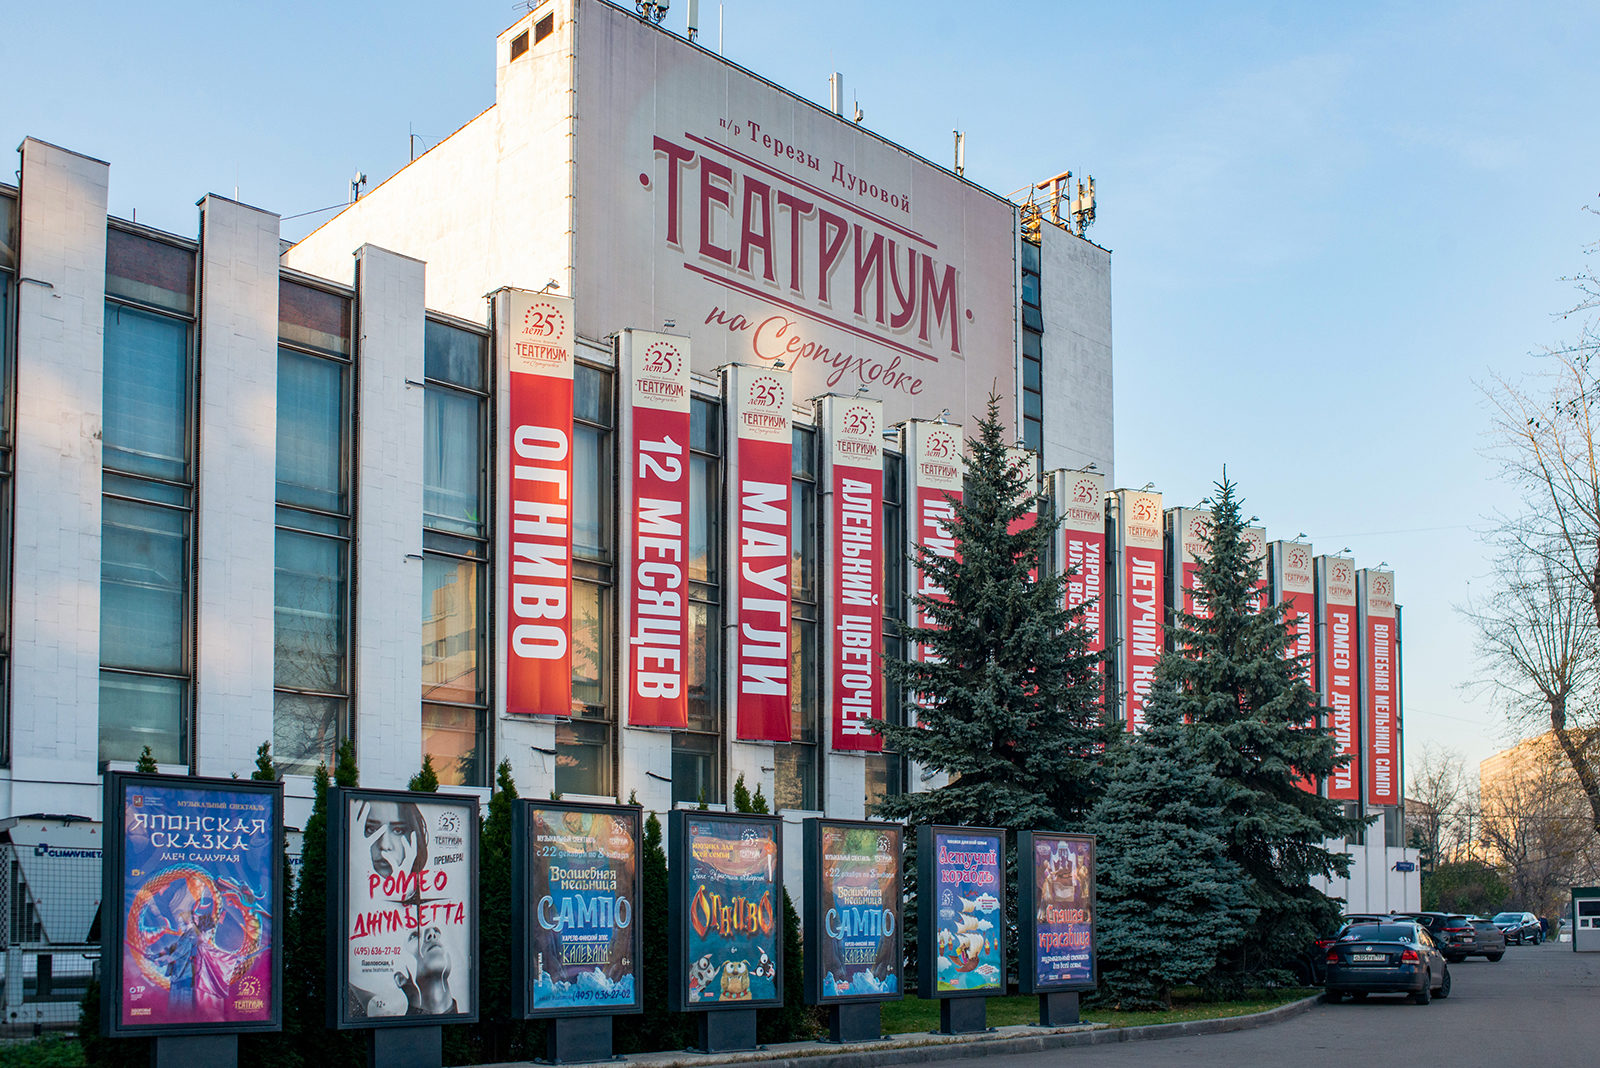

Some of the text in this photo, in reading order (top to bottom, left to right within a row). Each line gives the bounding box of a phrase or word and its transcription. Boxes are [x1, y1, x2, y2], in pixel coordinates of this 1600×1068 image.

[719, 117, 911, 214] п/р Терезы Дуровой
[653, 135, 961, 354] ТЕАТРИУМ
[522, 326, 544, 337] лет
[532, 312, 556, 337] 25
[516, 342, 567, 362] ТЕАТРИУМ
[704, 305, 924, 396] на Серпуховке
[643, 363, 663, 373] лет
[652, 350, 674, 374] 25
[637, 379, 684, 397] ТЕАТРИУМ
[756, 384, 777, 406] 25
[747, 397, 767, 406] лет
[742, 412, 786, 429] ТЕАТРИУМ
[850, 413, 868, 435] 25
[841, 426, 859, 434] лет
[837, 440, 877, 456] ТЕАТРИУМ
[932, 438, 949, 458] 25
[639, 435, 683, 483] 12
[920, 463, 958, 478] ТЕАТРИУМ
[1078, 485, 1093, 503] 25
[1069, 508, 1100, 521] ТЕАТРИУМ
[1137, 504, 1152, 521] 25
[1128, 526, 1159, 537] ТЕАТРИУМ
[512, 424, 568, 660] ОГНИВО
[842, 478, 878, 607] АЛЕНЬКИЙ
[1292, 554, 1303, 568] 25
[1335, 568, 1346, 582] 25
[742, 479, 787, 697] МАУГЛИ
[1376, 581, 1387, 595] 25
[630, 497, 682, 700] МЕСЯЦЕВ
[1132, 557, 1162, 657] ЛЕТУЧИЙ
[1333, 612, 1349, 670] РОМЕО
[837, 614, 872, 736] ЦВЕТОЧЕК
[1333, 675, 1350, 687] И
[1373, 624, 1390, 797] ВОЛШЕБНАЯ МЕЛЬНИЦА САМПО
[177, 800, 265, 811] МУЗЫКАЛЬНЫЙ СПЕКТАКЛЬ
[129, 813, 265, 836] ЯПОНСКАЯ
[443, 817, 456, 831] 25
[151, 832, 249, 850] СКАЗКА
[160, 852, 240, 863] МЕЧ САМУРАЯ
[542, 846, 557, 857] 22
[939, 845, 997, 869] Летучий
[550, 866, 617, 881] Волшебная
[829, 868, 840, 877] 22
[941, 864, 994, 887] корабль
[368, 870, 448, 899] РОМЕО
[561, 880, 617, 892] мельница
[837, 886, 882, 898] Волшебная
[349, 902, 466, 941] ДЖУЛЬЕТТА
[537, 894, 632, 932] САМПО
[825, 907, 895, 940] САМПО
[1039, 924, 1090, 953] красавица
[354, 946, 401, 957] (495) 636-27-02
[562, 944, 609, 963] КАЛЕВАЛА
[621, 957, 630, 966] 6+
[243, 981, 255, 996] 25
[572, 990, 593, 1002] (495)
[595, 990, 631, 1000] 636-27-02
